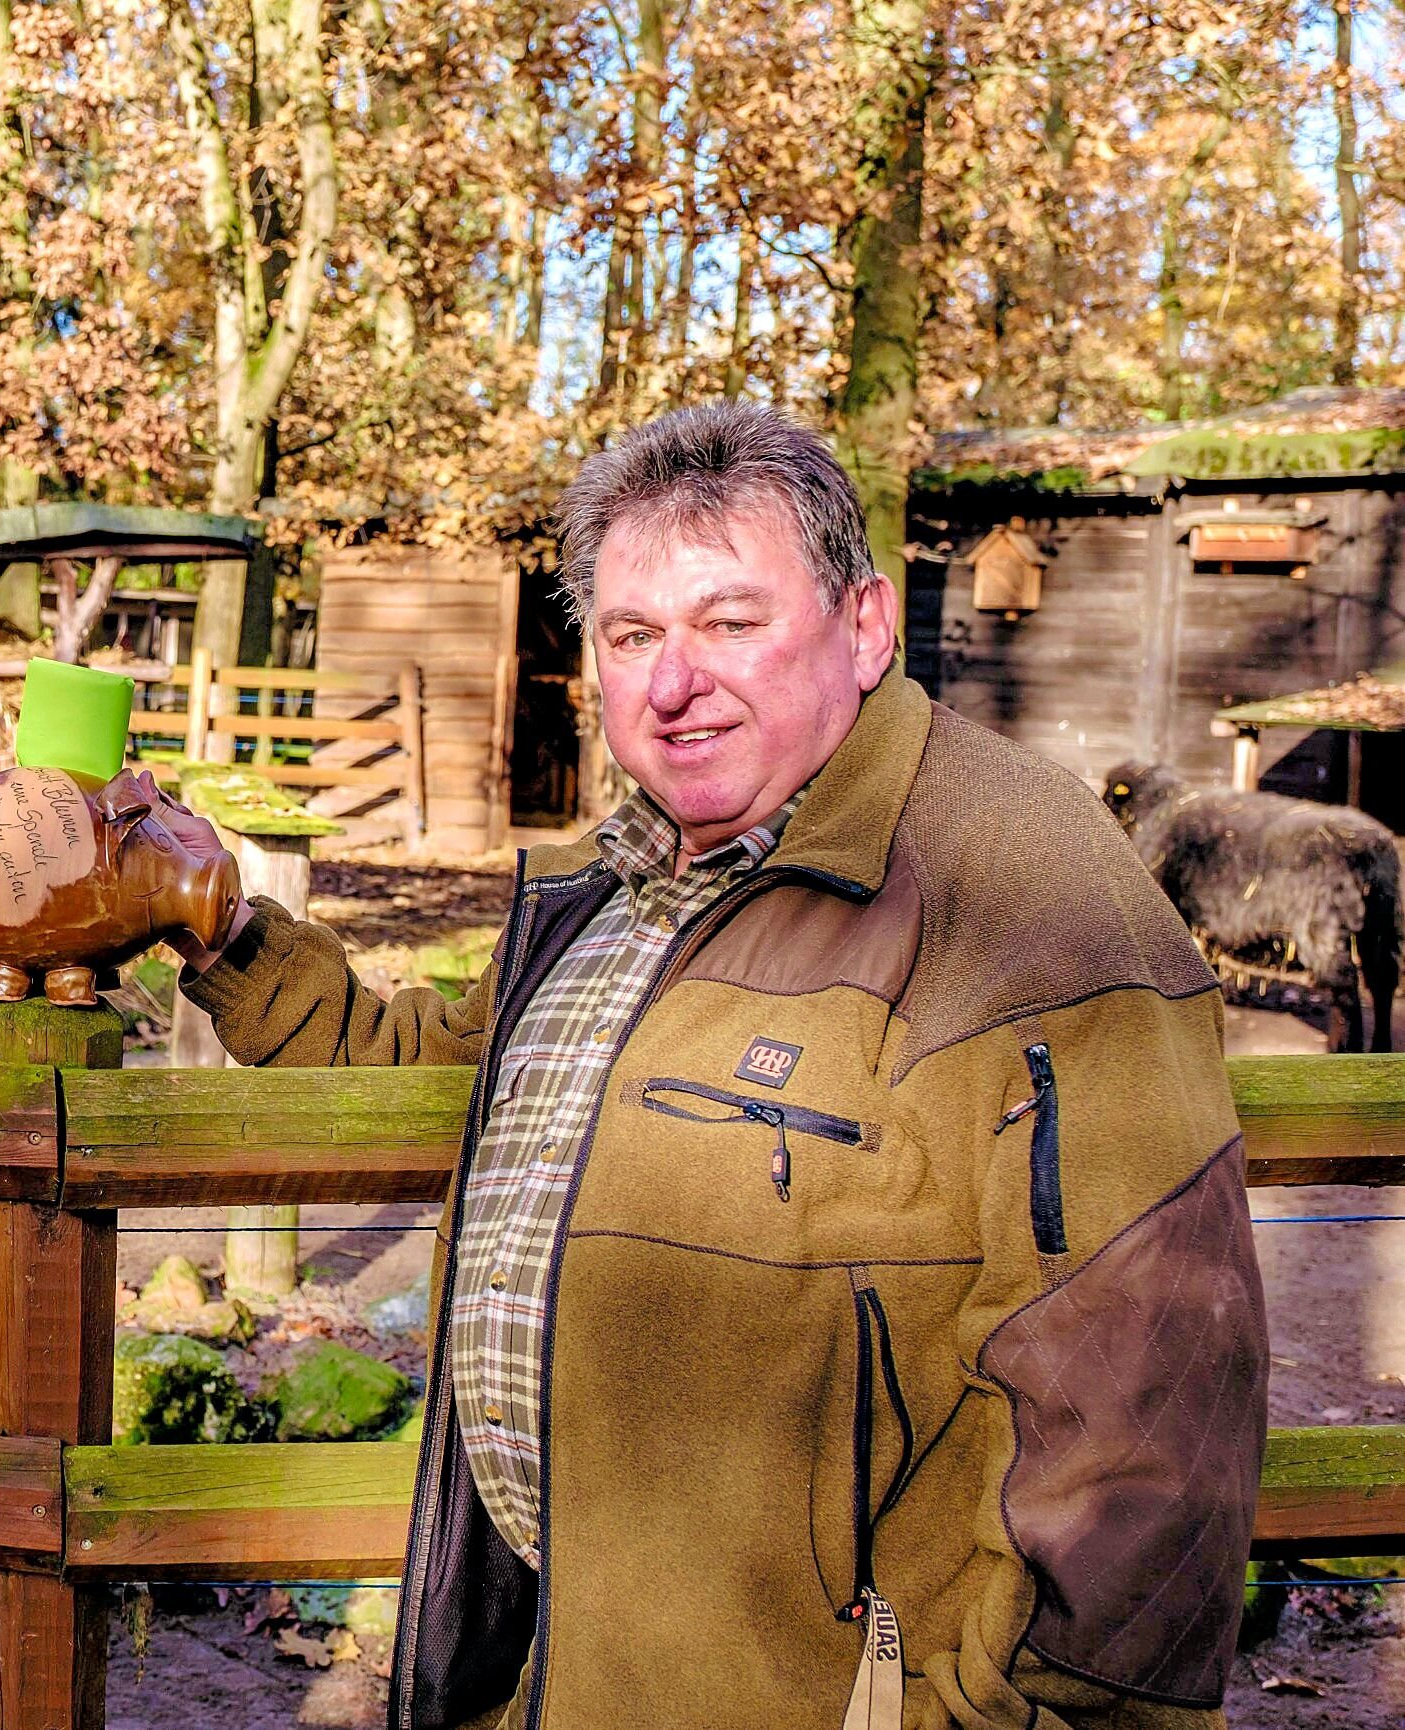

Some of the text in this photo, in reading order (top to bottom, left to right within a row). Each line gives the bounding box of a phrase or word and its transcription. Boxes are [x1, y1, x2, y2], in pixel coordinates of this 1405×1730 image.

[8, 781, 58, 871] eine Spende
[42, 783, 81, 850] Blumen
